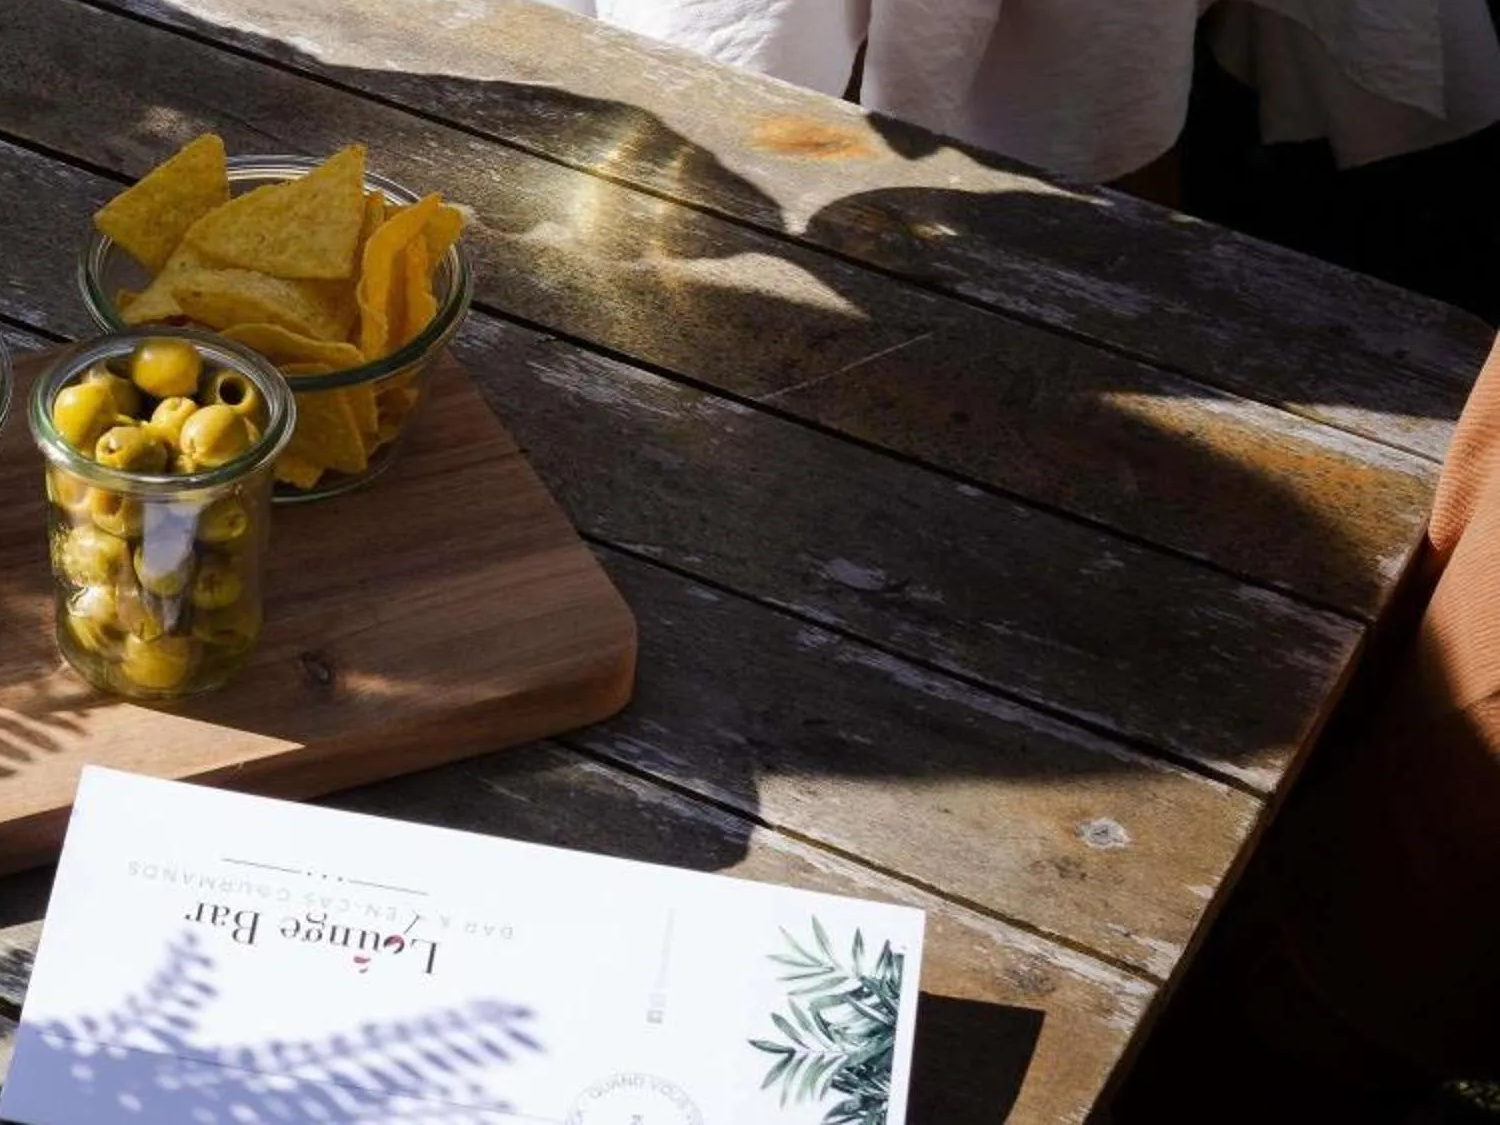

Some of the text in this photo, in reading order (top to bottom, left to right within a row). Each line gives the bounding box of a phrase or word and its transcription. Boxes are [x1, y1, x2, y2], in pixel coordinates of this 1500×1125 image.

[128, 860, 291, 902] GOURMANDS
[184, 902, 438, 975] Lounge Bar
